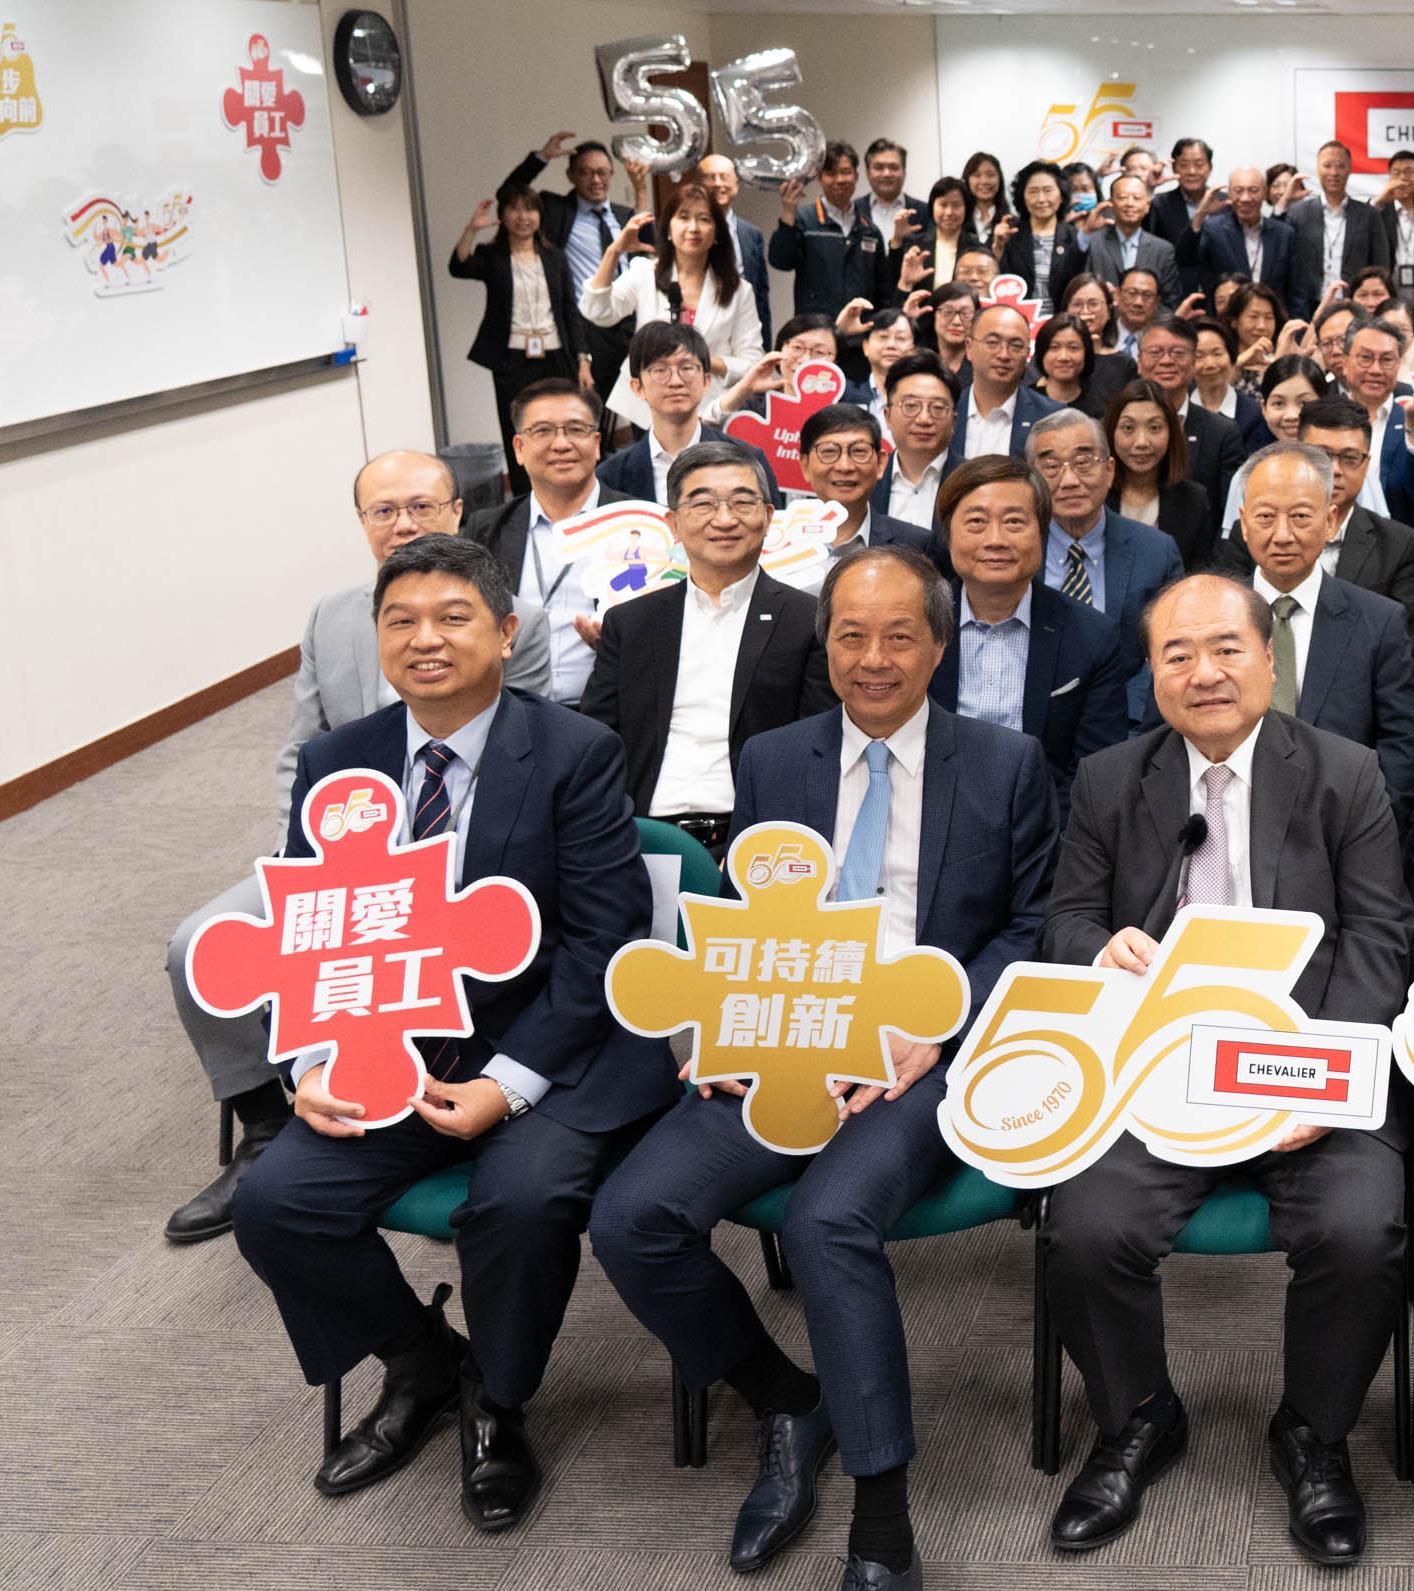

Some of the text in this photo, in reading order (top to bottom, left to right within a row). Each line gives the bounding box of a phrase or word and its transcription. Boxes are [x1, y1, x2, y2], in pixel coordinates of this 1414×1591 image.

[773, 427, 801, 444] Uph
[776, 445, 801, 461] Int
[281, 877, 416, 956] 關愛
[310, 947, 444, 1023] 員工
[704, 937, 868, 984] 可持續
[716, 993, 857, 1050] 創新
[951, 917, 1312, 1177] 55
[1248, 1062, 1317, 1081] CHEVALIER
[1001, 1080, 1074, 1132] Since 1970
